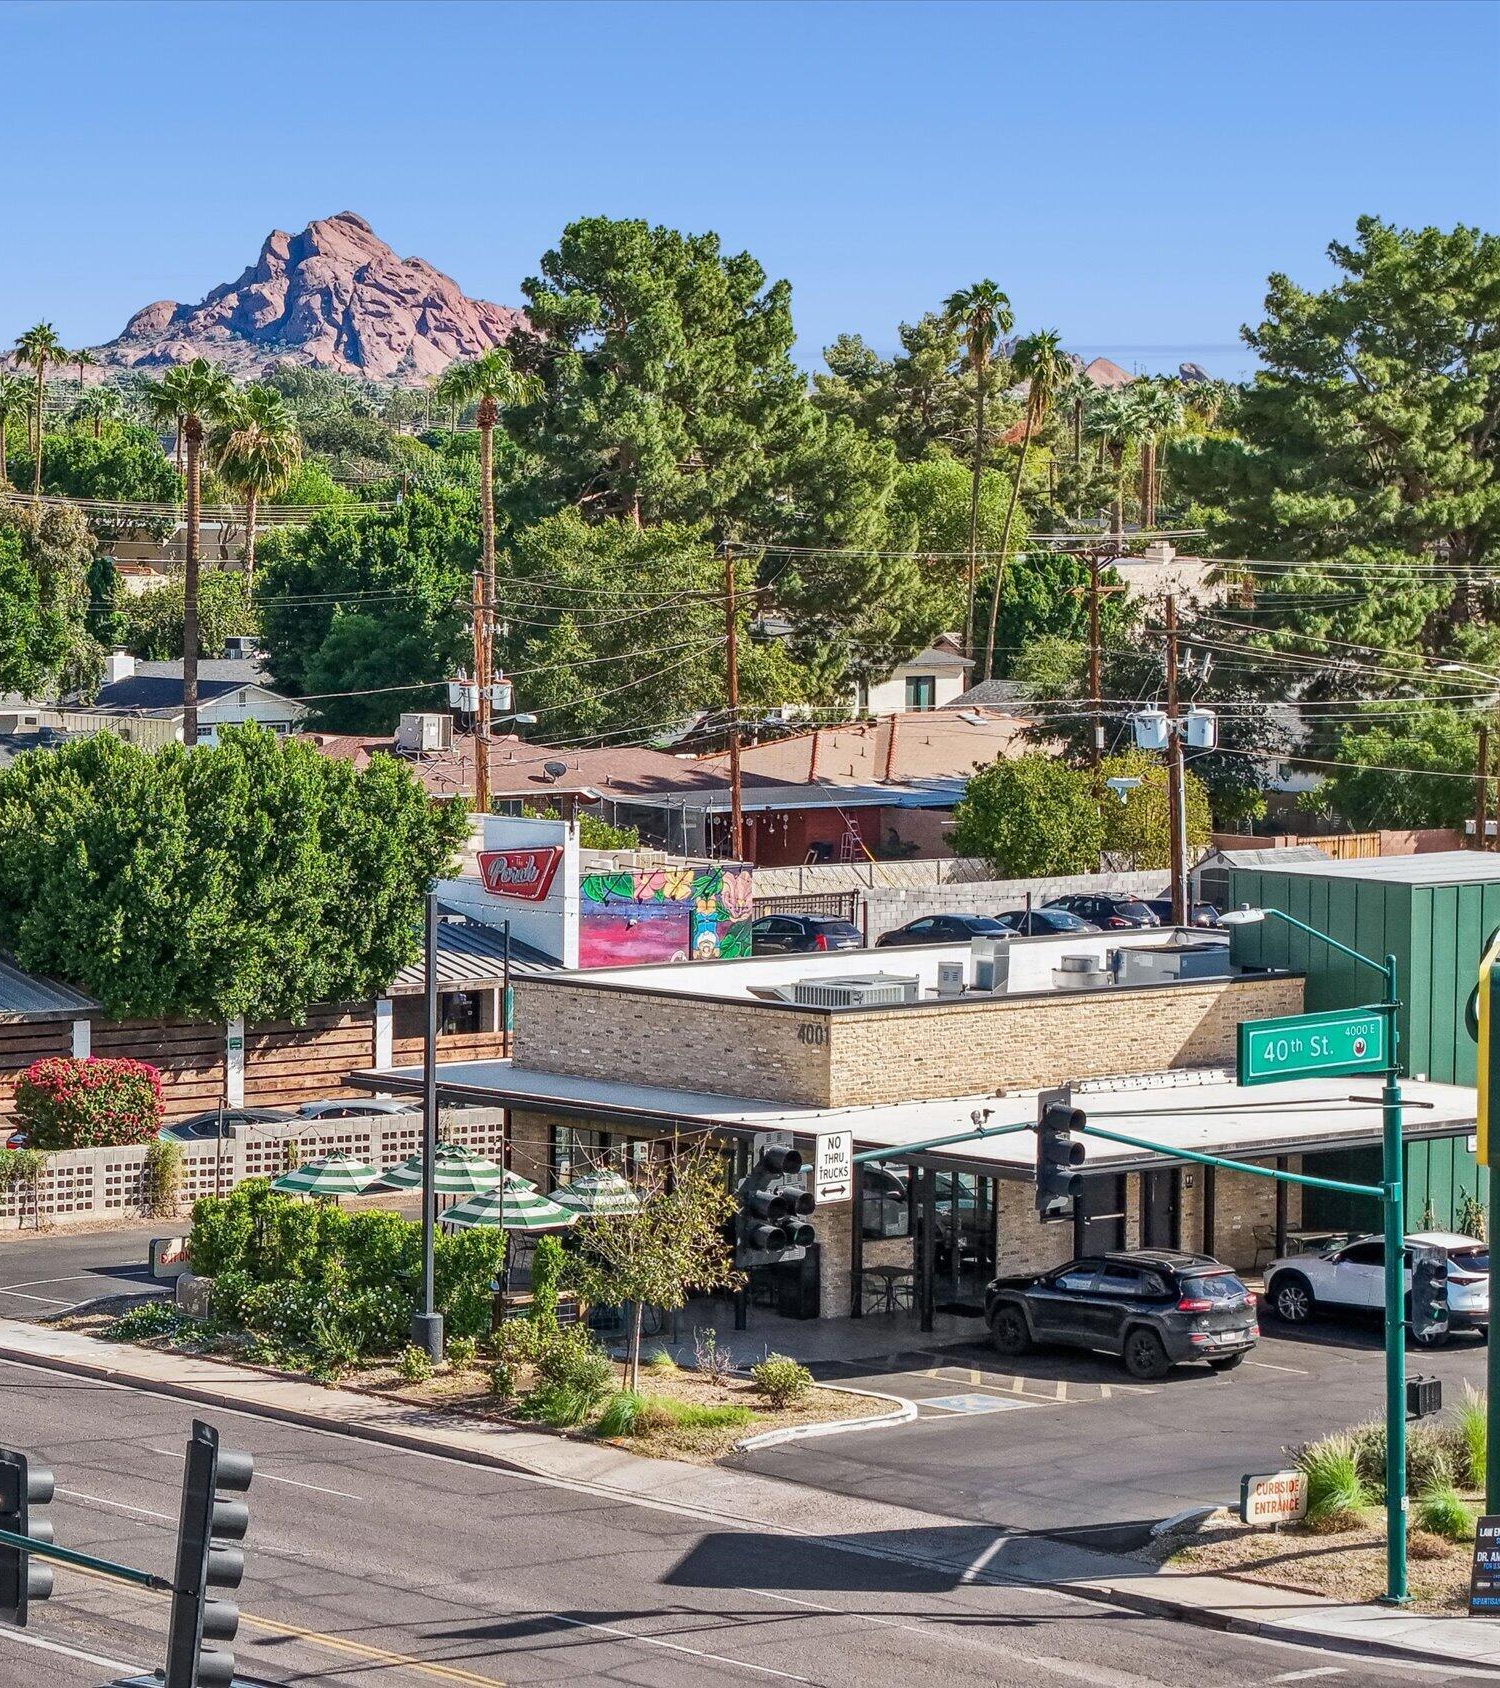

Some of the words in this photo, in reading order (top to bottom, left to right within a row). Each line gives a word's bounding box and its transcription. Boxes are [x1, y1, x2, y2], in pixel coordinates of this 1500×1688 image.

[488, 855, 540, 887] Porch
[798, 1024, 830, 1046] 4001
[1345, 1025, 1367, 1037] 4000
[1370, 1023, 1375, 1034] E
[1263, 1038, 1303, 1062] 40th
[1310, 1035, 1334, 1057] St.
[827, 1135, 841, 1150] NO
[824, 1152, 845, 1164] THRU
[819, 1165, 849, 1181] TRUCKS
[1256, 1479, 1299, 1496] CURBSIDE
[1254, 1497, 1300, 1515] ENTRANCE
[1480, 1528, 1493, 1537] LAW
[1477, 1552, 1488, 1562] DR.
